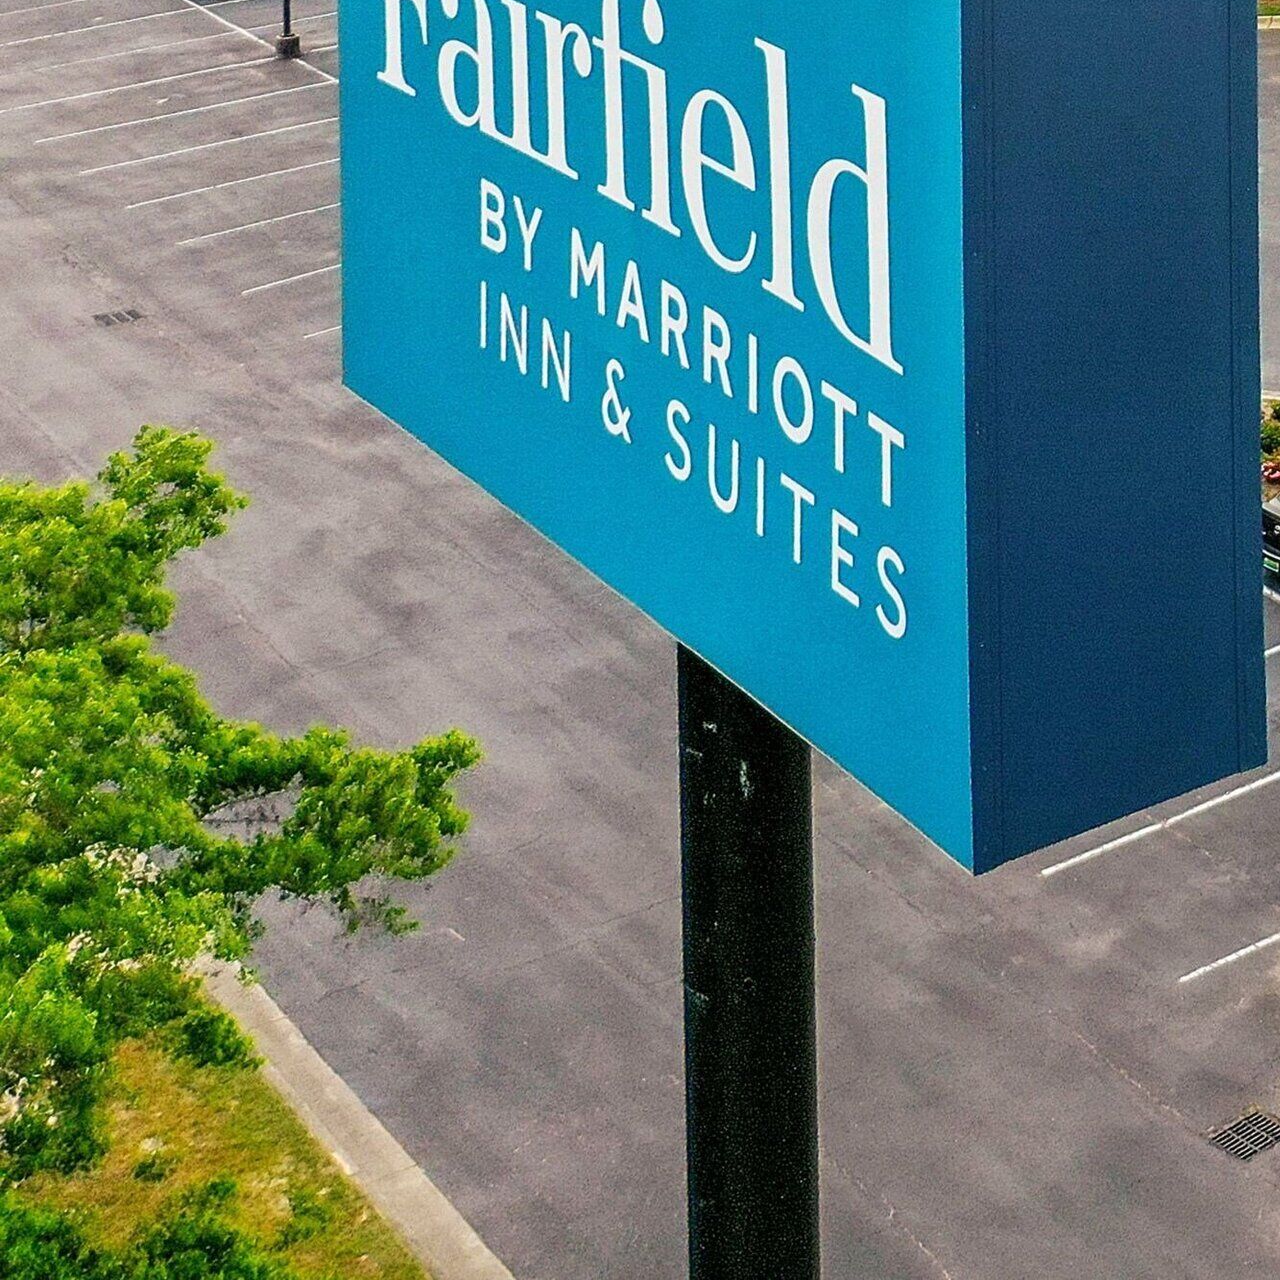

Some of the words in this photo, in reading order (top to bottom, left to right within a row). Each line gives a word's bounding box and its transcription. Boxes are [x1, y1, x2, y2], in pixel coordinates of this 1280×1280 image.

[480, 178, 543, 272] BY
[570, 227, 907, 508] MARRIOTT
[480, 281, 572, 403] INN
[601, 358, 634, 444] &
[664, 399, 907, 640] SUITES
